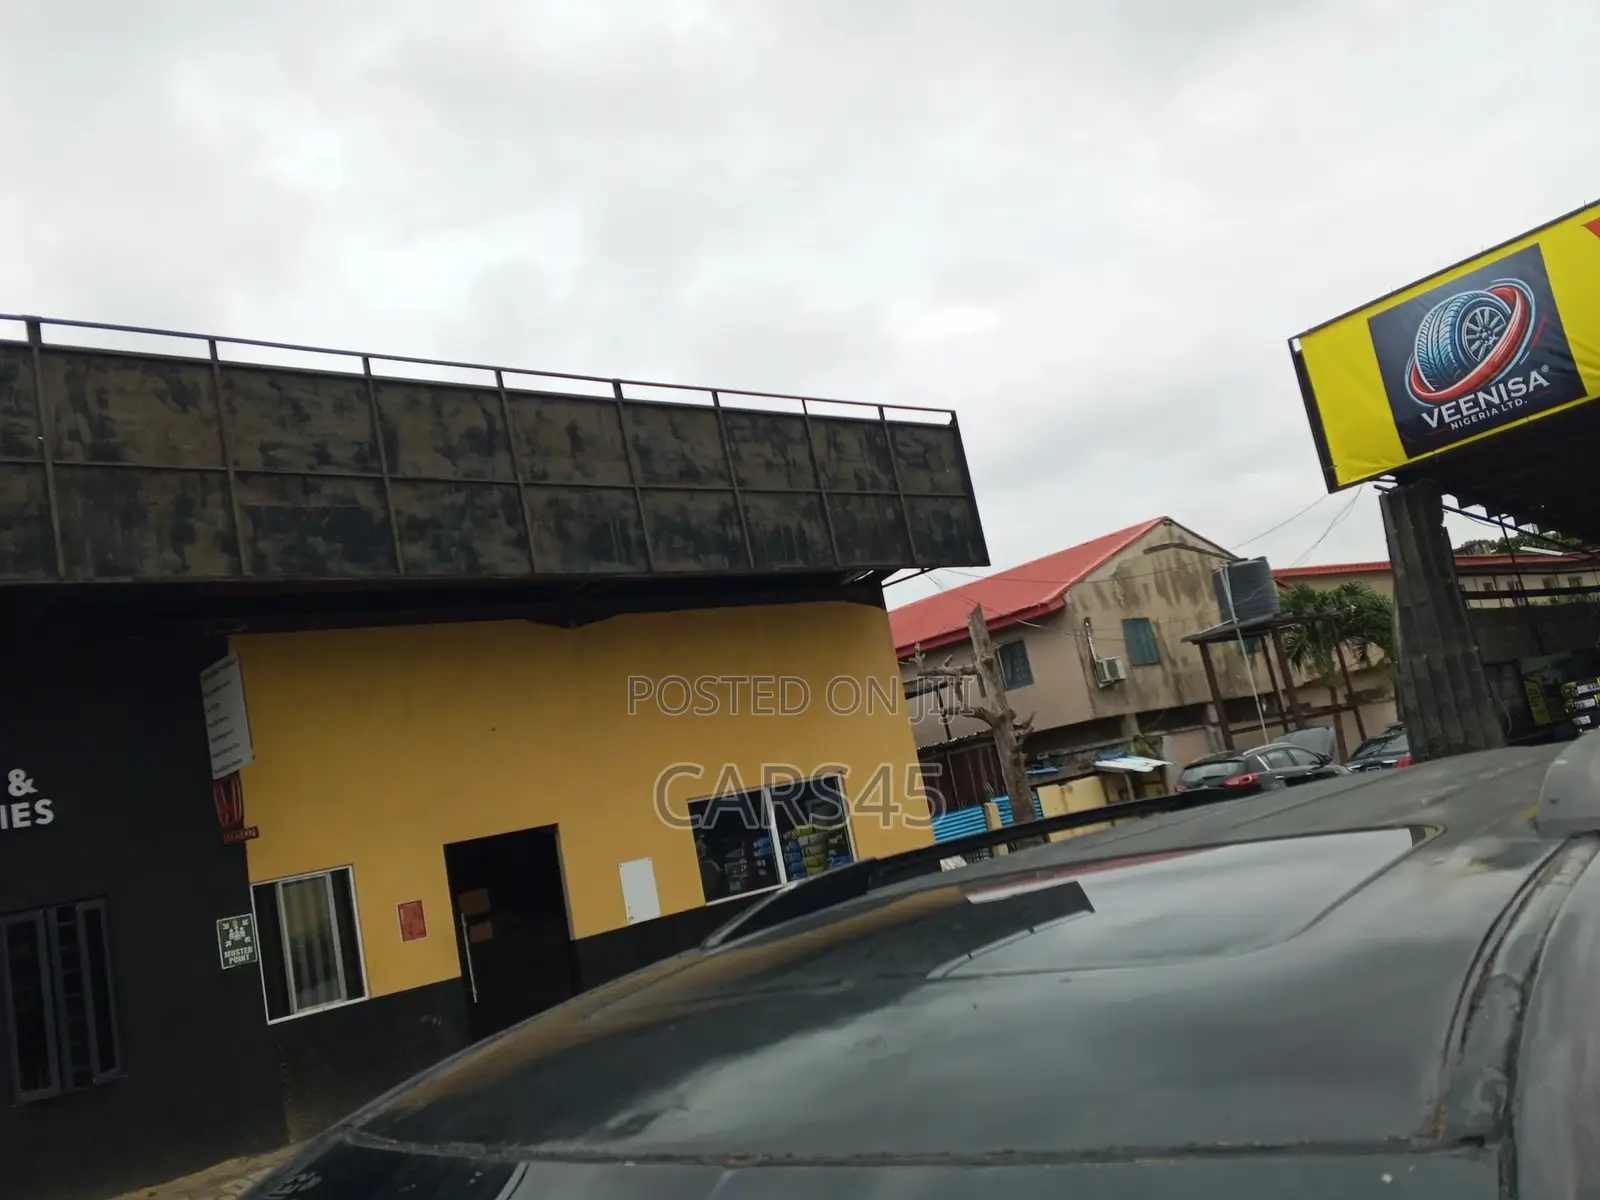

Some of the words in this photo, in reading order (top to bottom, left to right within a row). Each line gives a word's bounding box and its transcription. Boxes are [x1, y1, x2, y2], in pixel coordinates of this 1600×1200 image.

[1449, 408, 1499, 431] NIGERIA
[8, 768, 39, 797] &
[224, 945, 254, 959] MUSTER
[228, 953, 251, 965] POINT
